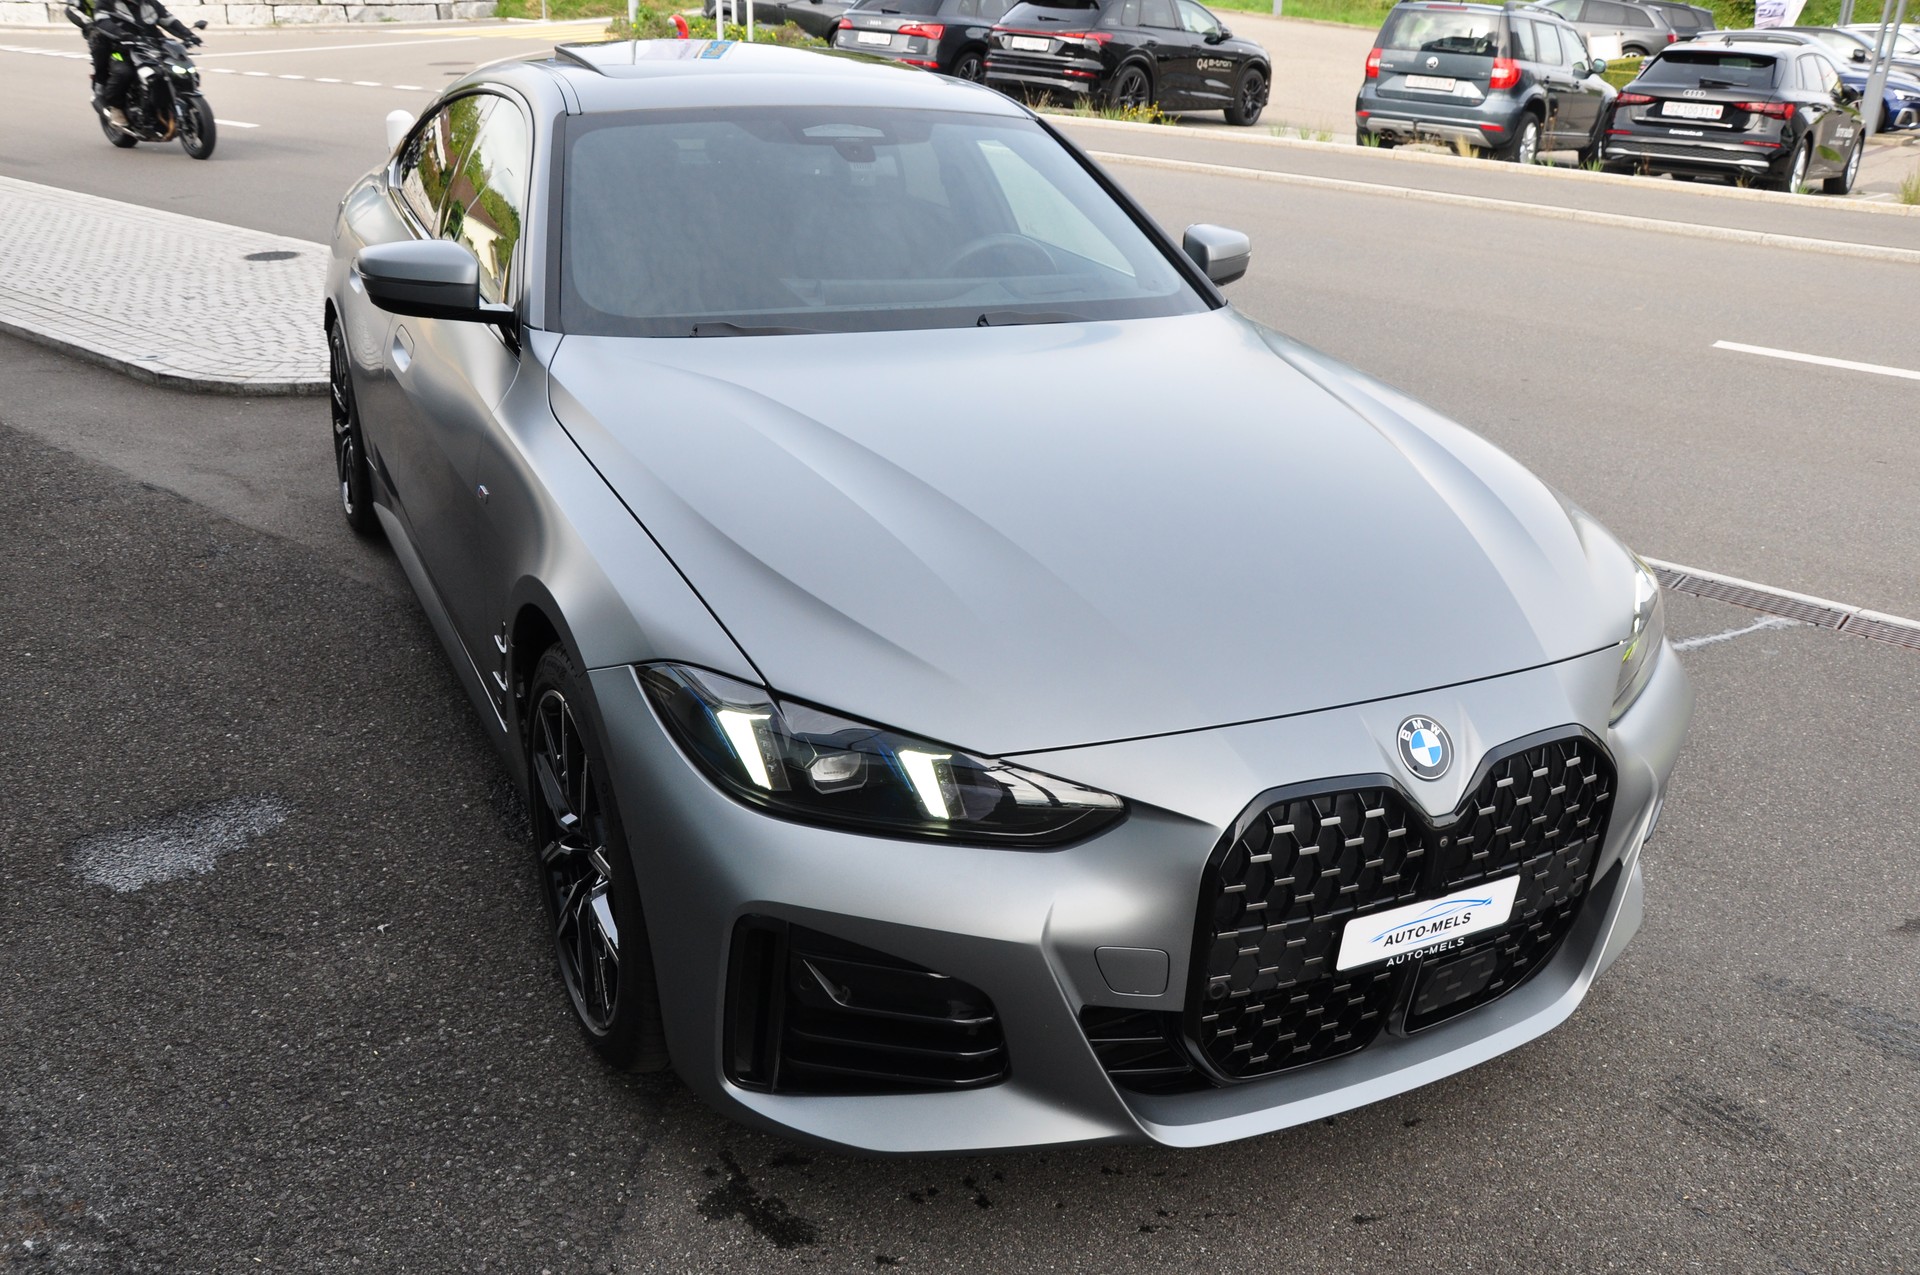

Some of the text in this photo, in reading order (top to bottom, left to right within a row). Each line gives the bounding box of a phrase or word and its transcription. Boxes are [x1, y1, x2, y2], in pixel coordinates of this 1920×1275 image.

[1400, 719, 1441, 742] BMW
[1383, 912, 1472, 947] AUTO-MELS
[1386, 937, 1465, 967] AUTO-MELS
